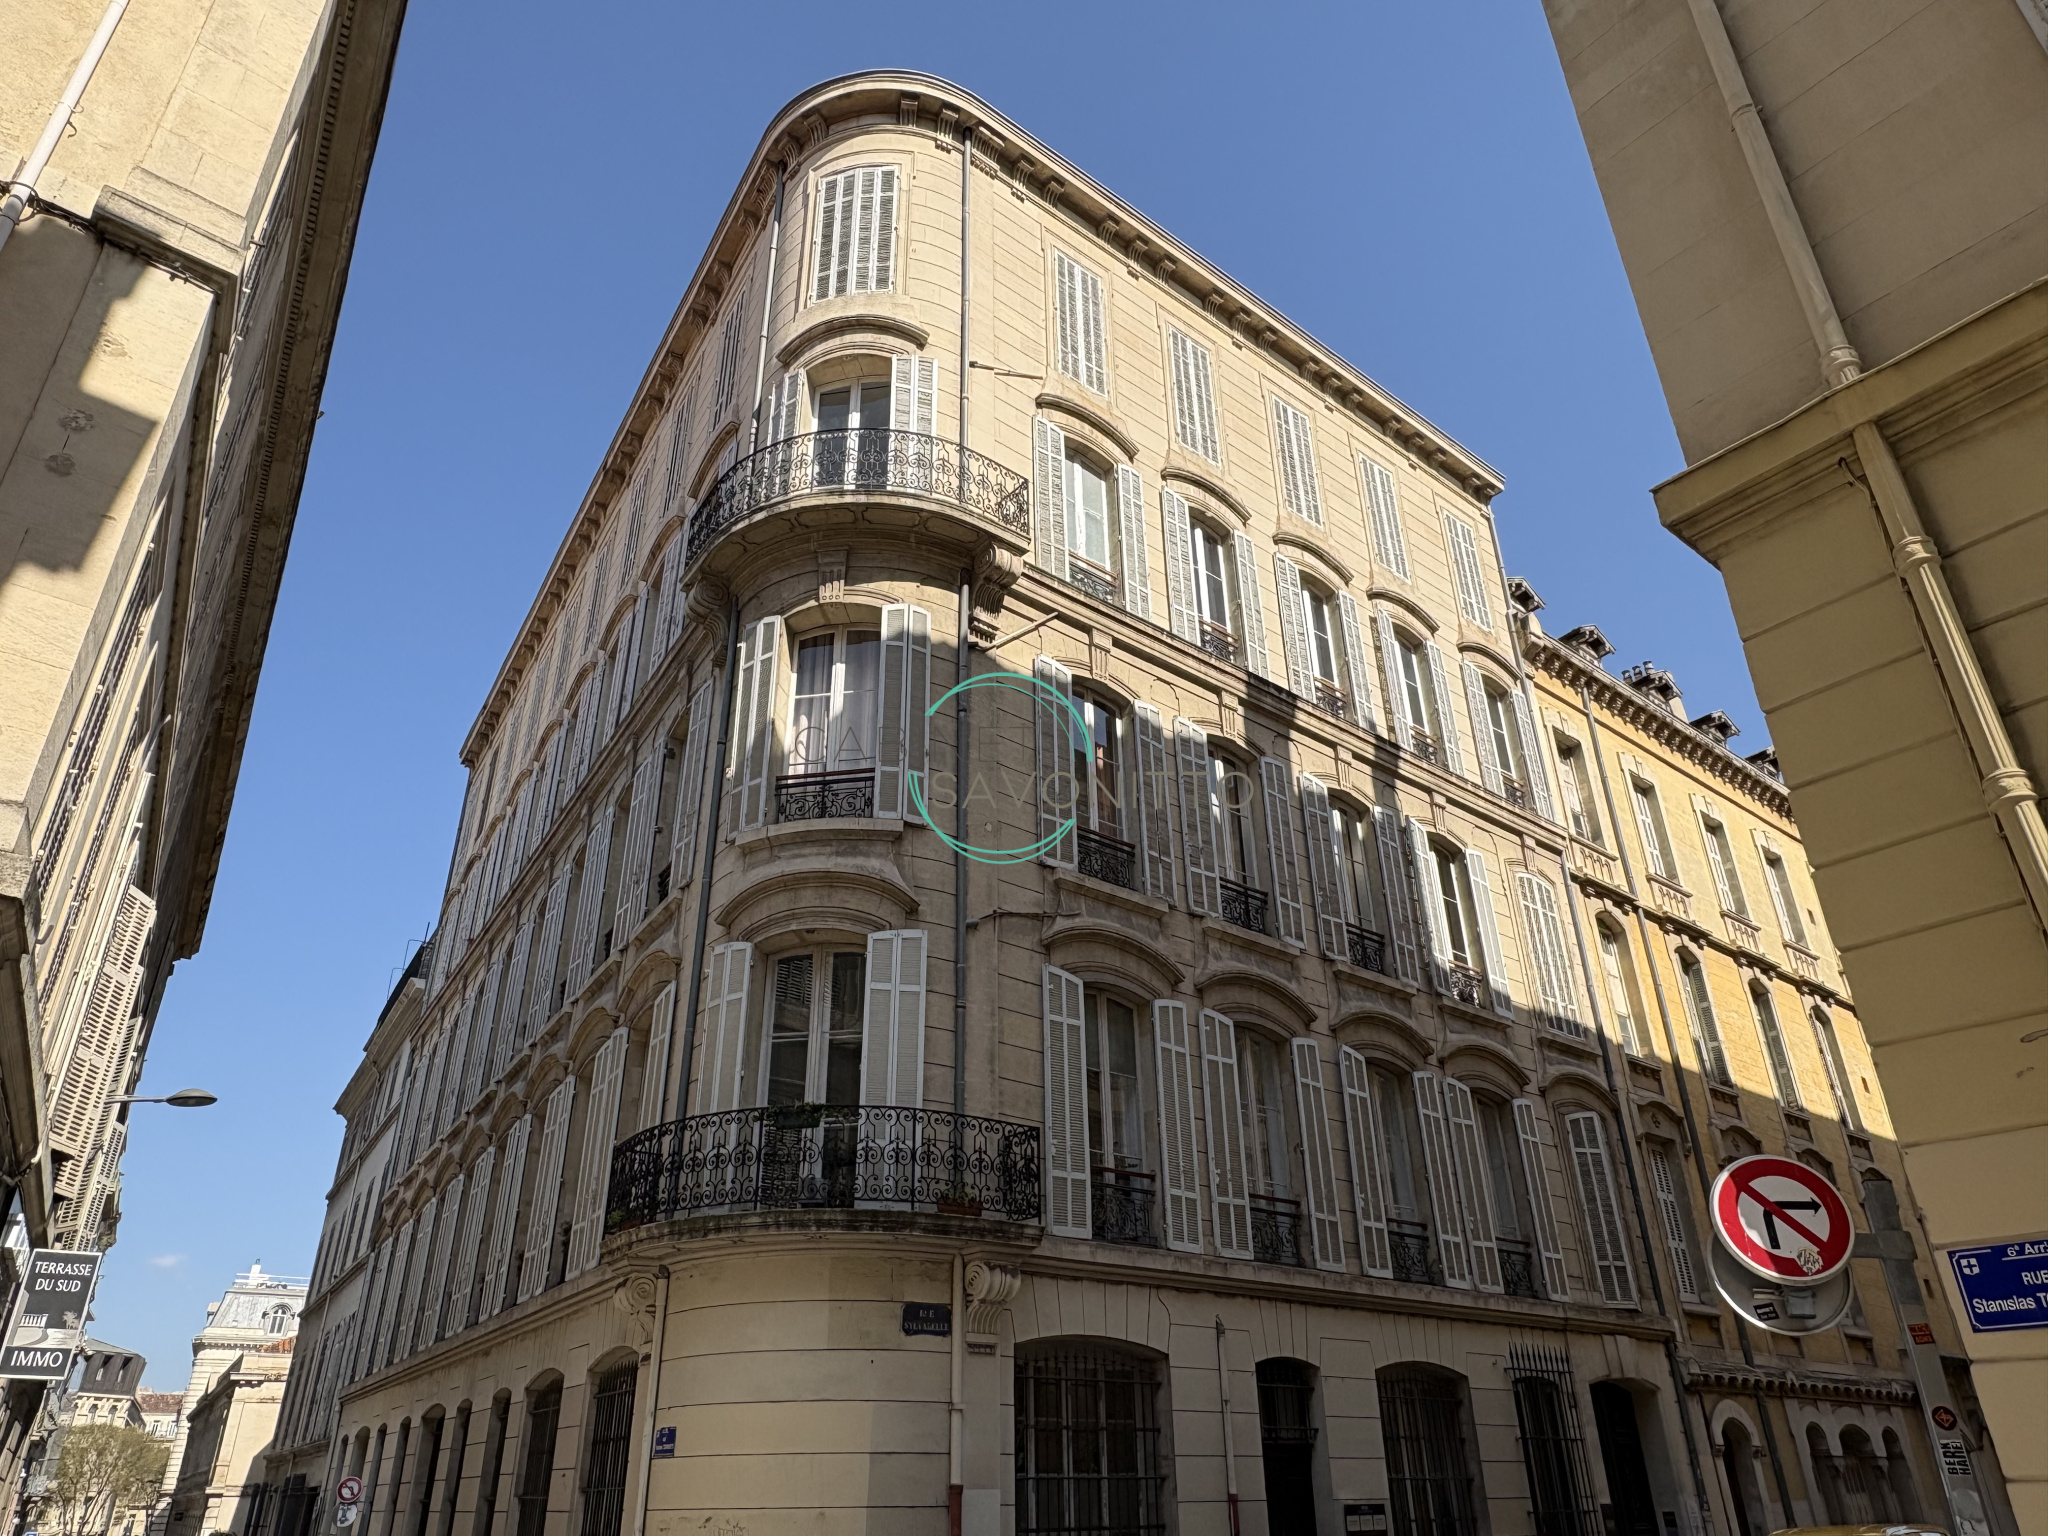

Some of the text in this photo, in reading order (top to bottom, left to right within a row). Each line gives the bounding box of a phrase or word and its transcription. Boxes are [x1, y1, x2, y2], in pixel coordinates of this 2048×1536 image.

[35, 1262, 93, 1275] TERRASSE
[35, 1278, 81, 1292] DU SUD
[1973, 1295, 2036, 1313] Stanislas
[11, 1350, 63, 1367] IMMO
